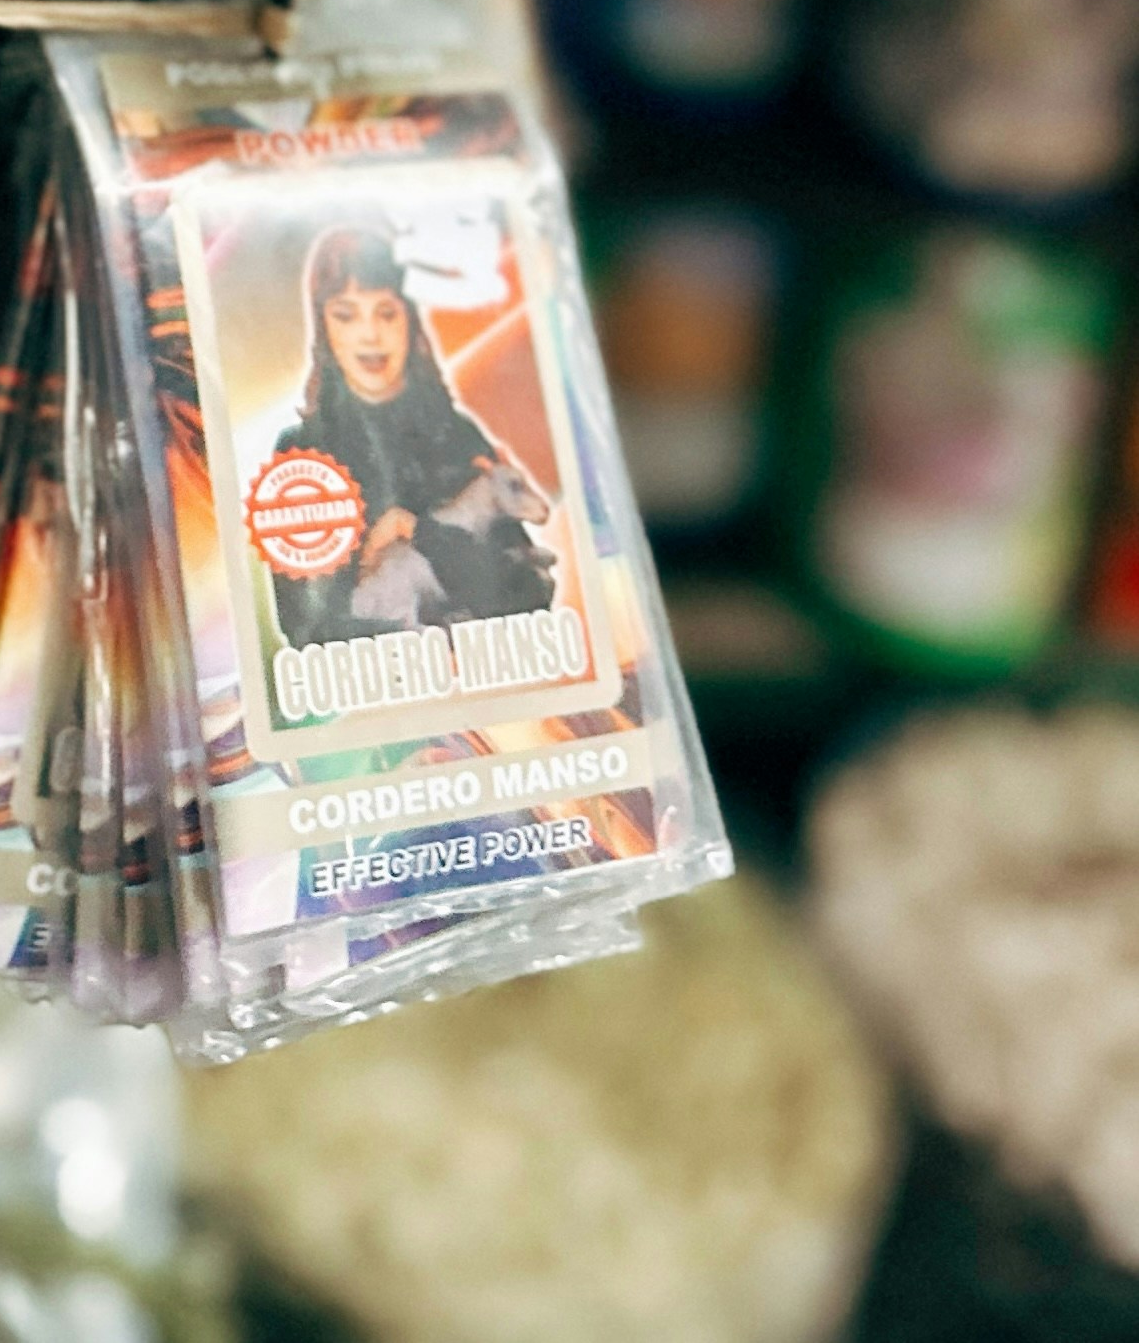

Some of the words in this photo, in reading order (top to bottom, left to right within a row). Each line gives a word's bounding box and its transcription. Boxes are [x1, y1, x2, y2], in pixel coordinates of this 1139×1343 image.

[273, 624, 455, 723] CORDERO
[451, 605, 591, 692] MANSO
[287, 770, 482, 835] CORDERO
[491, 744, 630, 801] MANSO
[309, 835, 478, 898] EFFECTIVE
[481, 815, 595, 866] POWER
